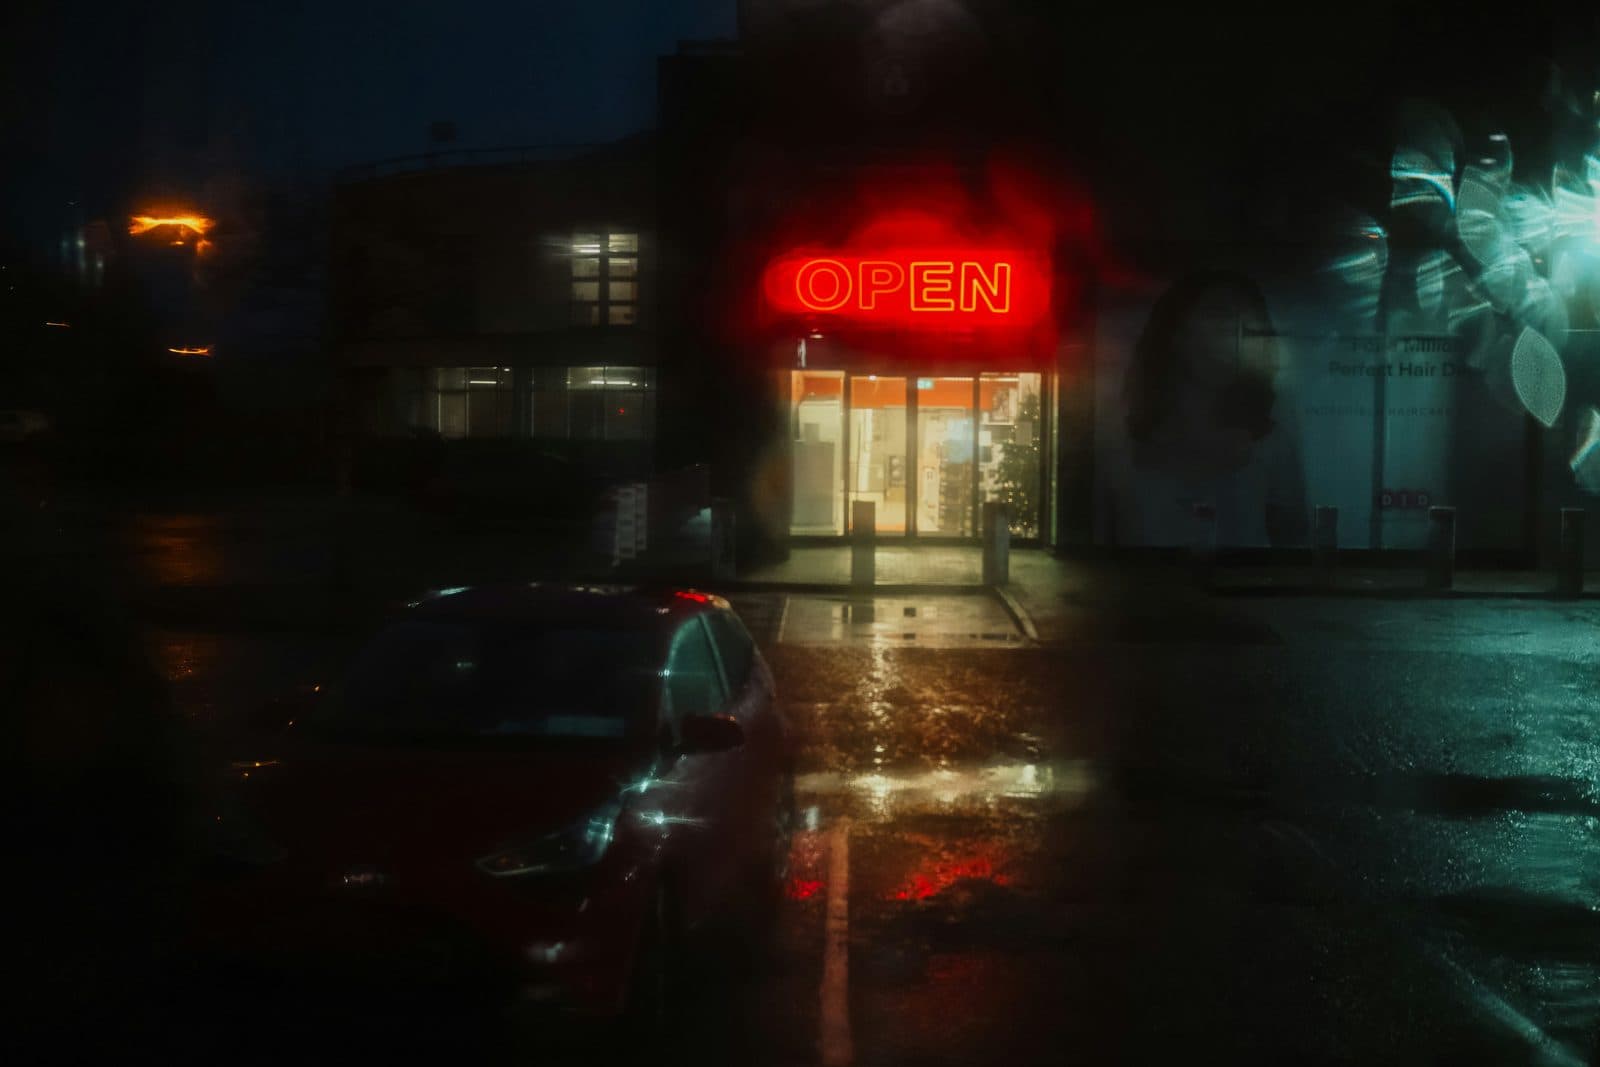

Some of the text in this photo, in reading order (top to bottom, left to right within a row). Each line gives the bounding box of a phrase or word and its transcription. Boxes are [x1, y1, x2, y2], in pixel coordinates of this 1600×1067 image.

[795, 258, 1011, 313] OPEN
[1402, 337, 1455, 352] Millio
[1328, 361, 1392, 377] Perfect
[1398, 361, 1436, 377] Hair
